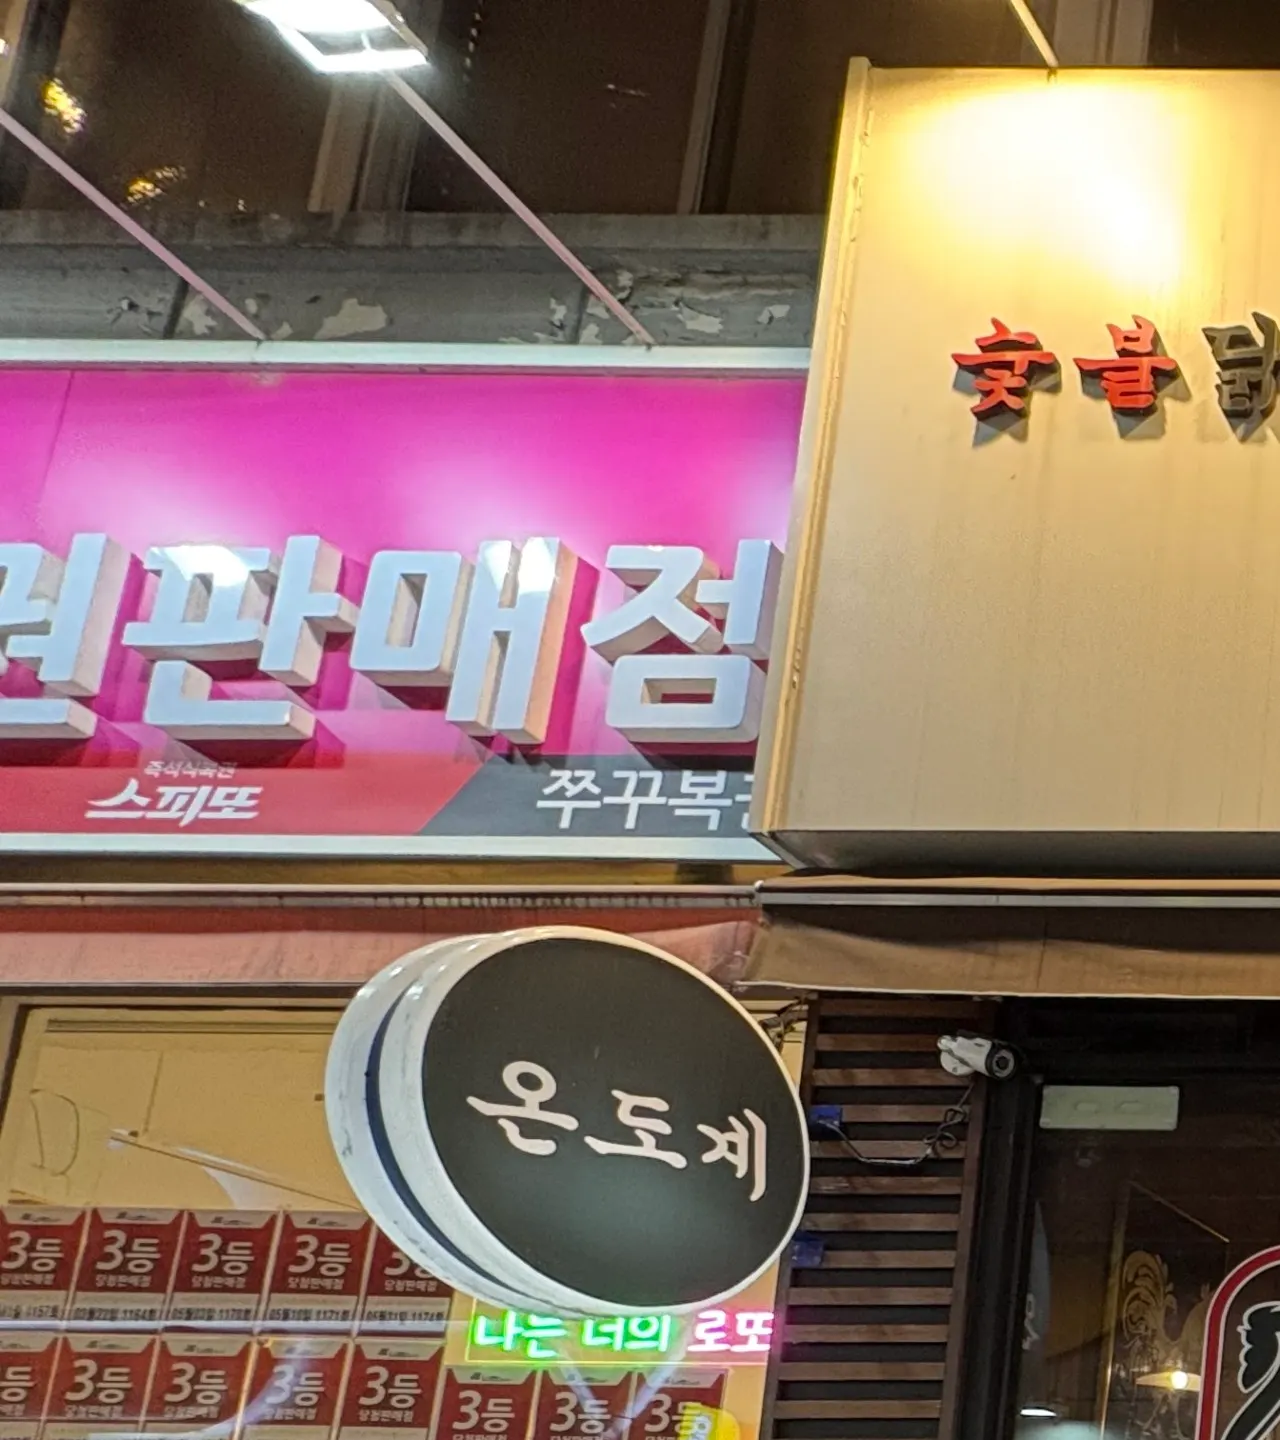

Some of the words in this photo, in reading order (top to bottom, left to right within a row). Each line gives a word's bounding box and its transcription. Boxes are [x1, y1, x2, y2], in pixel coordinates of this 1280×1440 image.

[85, 778, 264, 828] 스피또
[467, 1060, 767, 1202] 온도계
[1, 1230, 64, 1272] 3등
[96, 1229, 161, 1273] 3등
[192, 1233, 255, 1275] 3등
[288, 1234, 352, 1277] 3등
[474, 1309, 567, 1358] 나는
[583, 1312, 672, 1353] 너의
[688, 1309, 774, 1353] 로또
[65, 1358, 132, 1403] 3등
[163, 1362, 228, 1404] 3등
[265, 1364, 325, 1406] 3등
[358, 1366, 422, 1408] 3등
[452, 1390, 515, 1433] 3등
[549, 1391, 612, 1434] 3등
